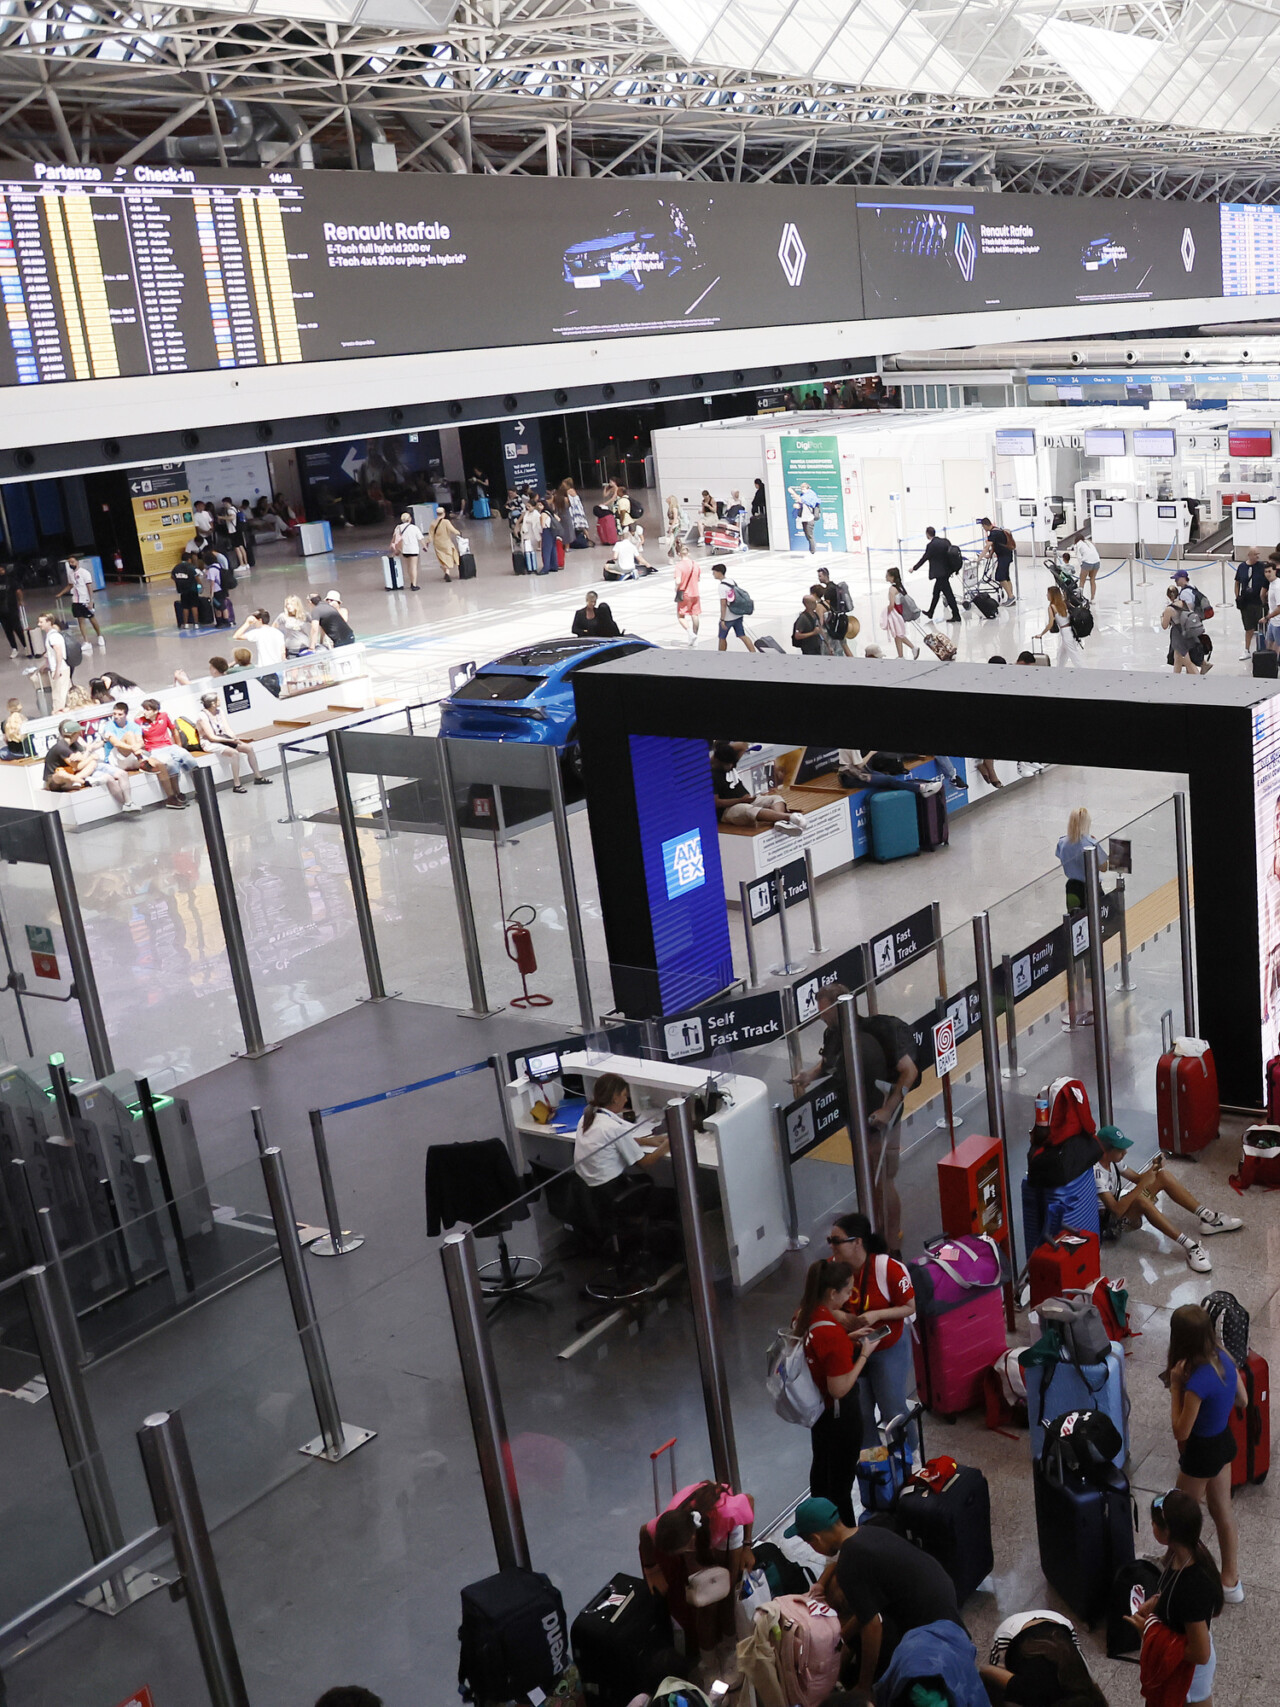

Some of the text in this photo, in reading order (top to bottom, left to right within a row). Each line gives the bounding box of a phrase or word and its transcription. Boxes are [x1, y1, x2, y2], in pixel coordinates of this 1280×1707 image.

[34, 163, 195, 183] Partenze Check-in
[323, 221, 450, 241] Renault Rafale
[981, 225, 1033, 237] Renault Rafale
[796, 441, 823, 450] DigiPort
[675, 838, 701, 868] AM
[678, 856, 705, 885] EX
[788, 881, 808, 897] Track
[896, 928, 911, 944] Fast
[897, 941, 917, 959] Track
[1032, 943, 1054, 964] Family
[821, 971, 838, 986] Fast
[1033, 963, 1049, 980] Lane
[708, 1011, 735, 1029] Self
[710, 1020, 779, 1046] Fast Track
[817, 1109, 839, 1130] Lane
